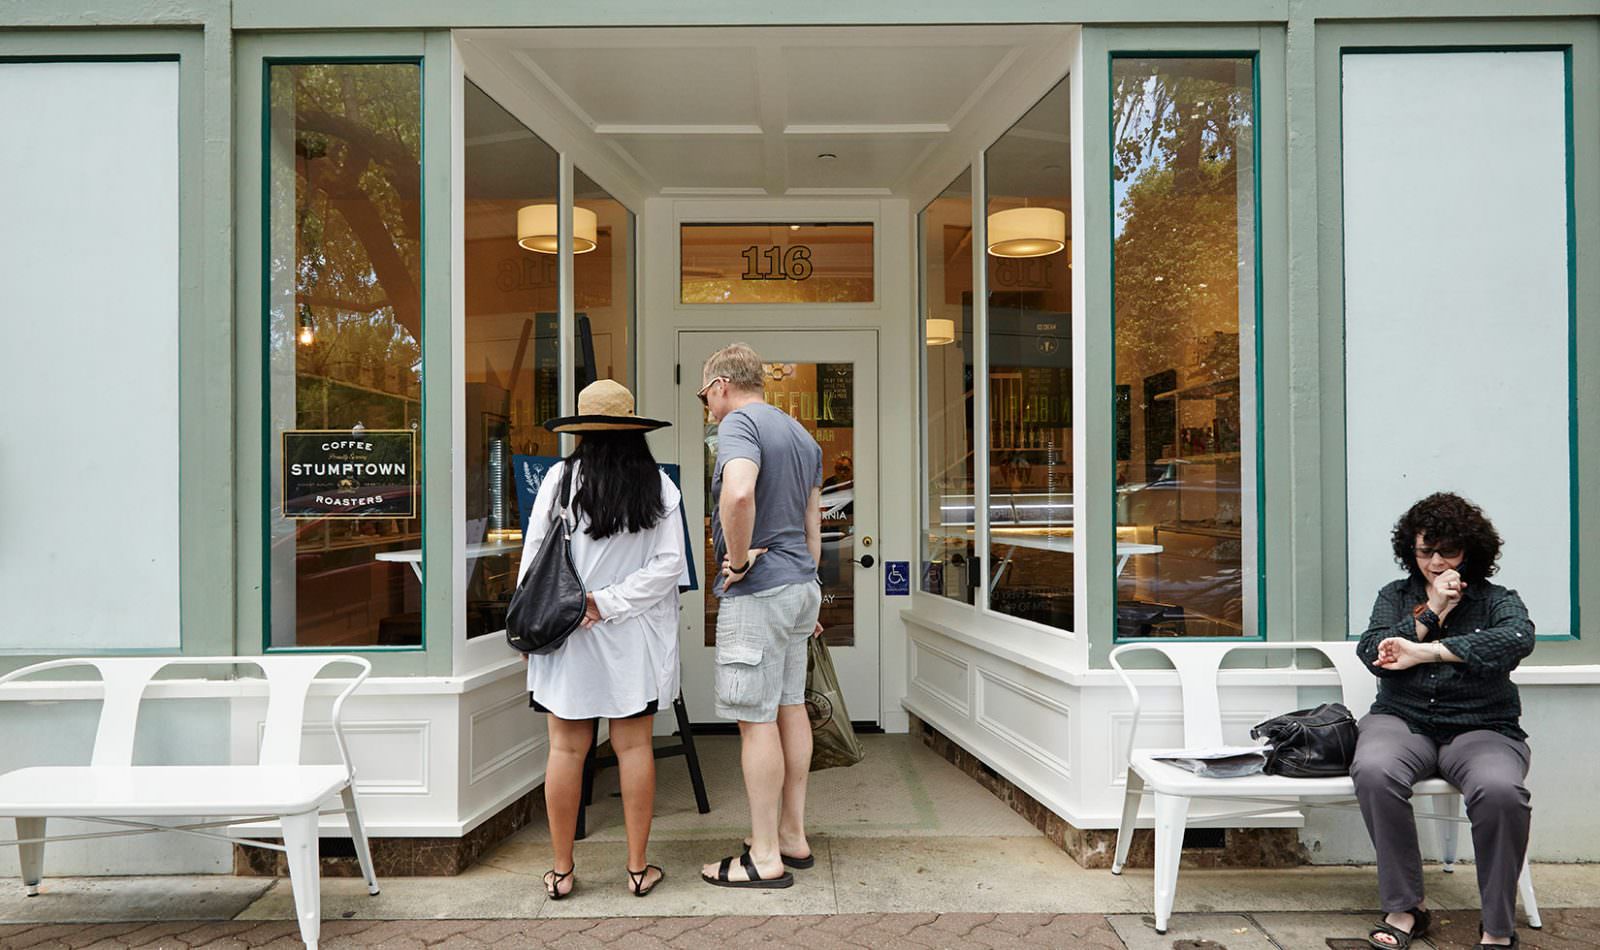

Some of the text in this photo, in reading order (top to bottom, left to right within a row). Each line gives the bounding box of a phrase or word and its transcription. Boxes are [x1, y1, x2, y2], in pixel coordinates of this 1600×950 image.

[742, 245, 813, 281] 116
[321, 441, 374, 451] COFFEE
[290, 463, 406, 476] STUMPTOWN
[315, 495, 384, 506] ROASTERS
